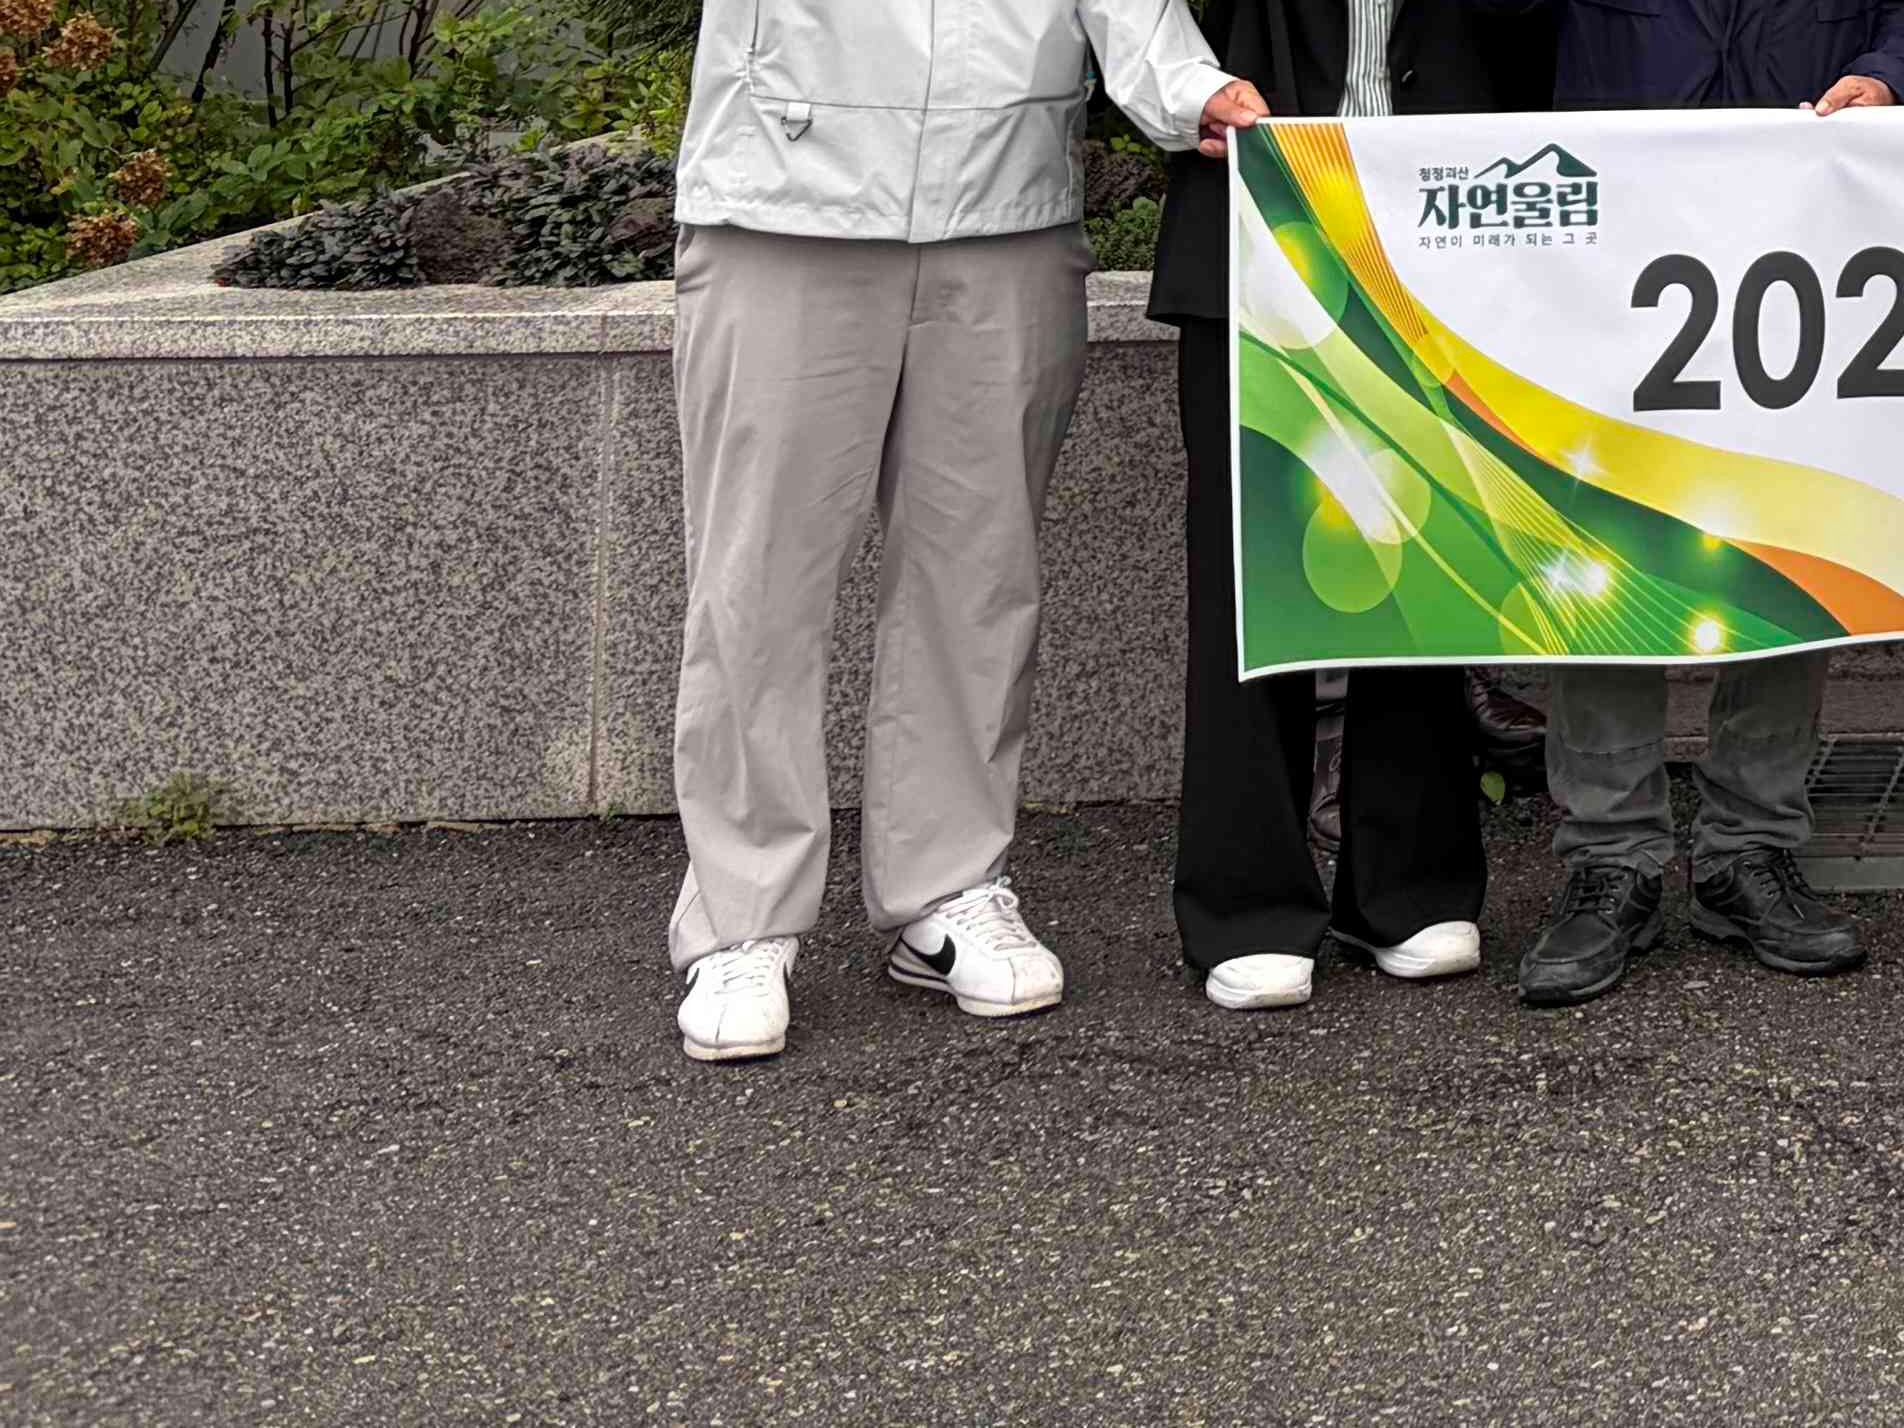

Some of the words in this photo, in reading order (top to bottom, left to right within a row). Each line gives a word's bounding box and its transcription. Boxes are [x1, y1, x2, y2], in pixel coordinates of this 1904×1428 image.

[1418, 166, 1470, 182] 청정괴산
[1417, 181, 1599, 230] 자연울림
[1418, 234, 1463, 249] 자연이
[1472, 233, 1516, 248] 미래가
[1525, 233, 1553, 247] 되는
[1562, 233, 1575, 245] 그
[1585, 231, 1598, 245] 곳
